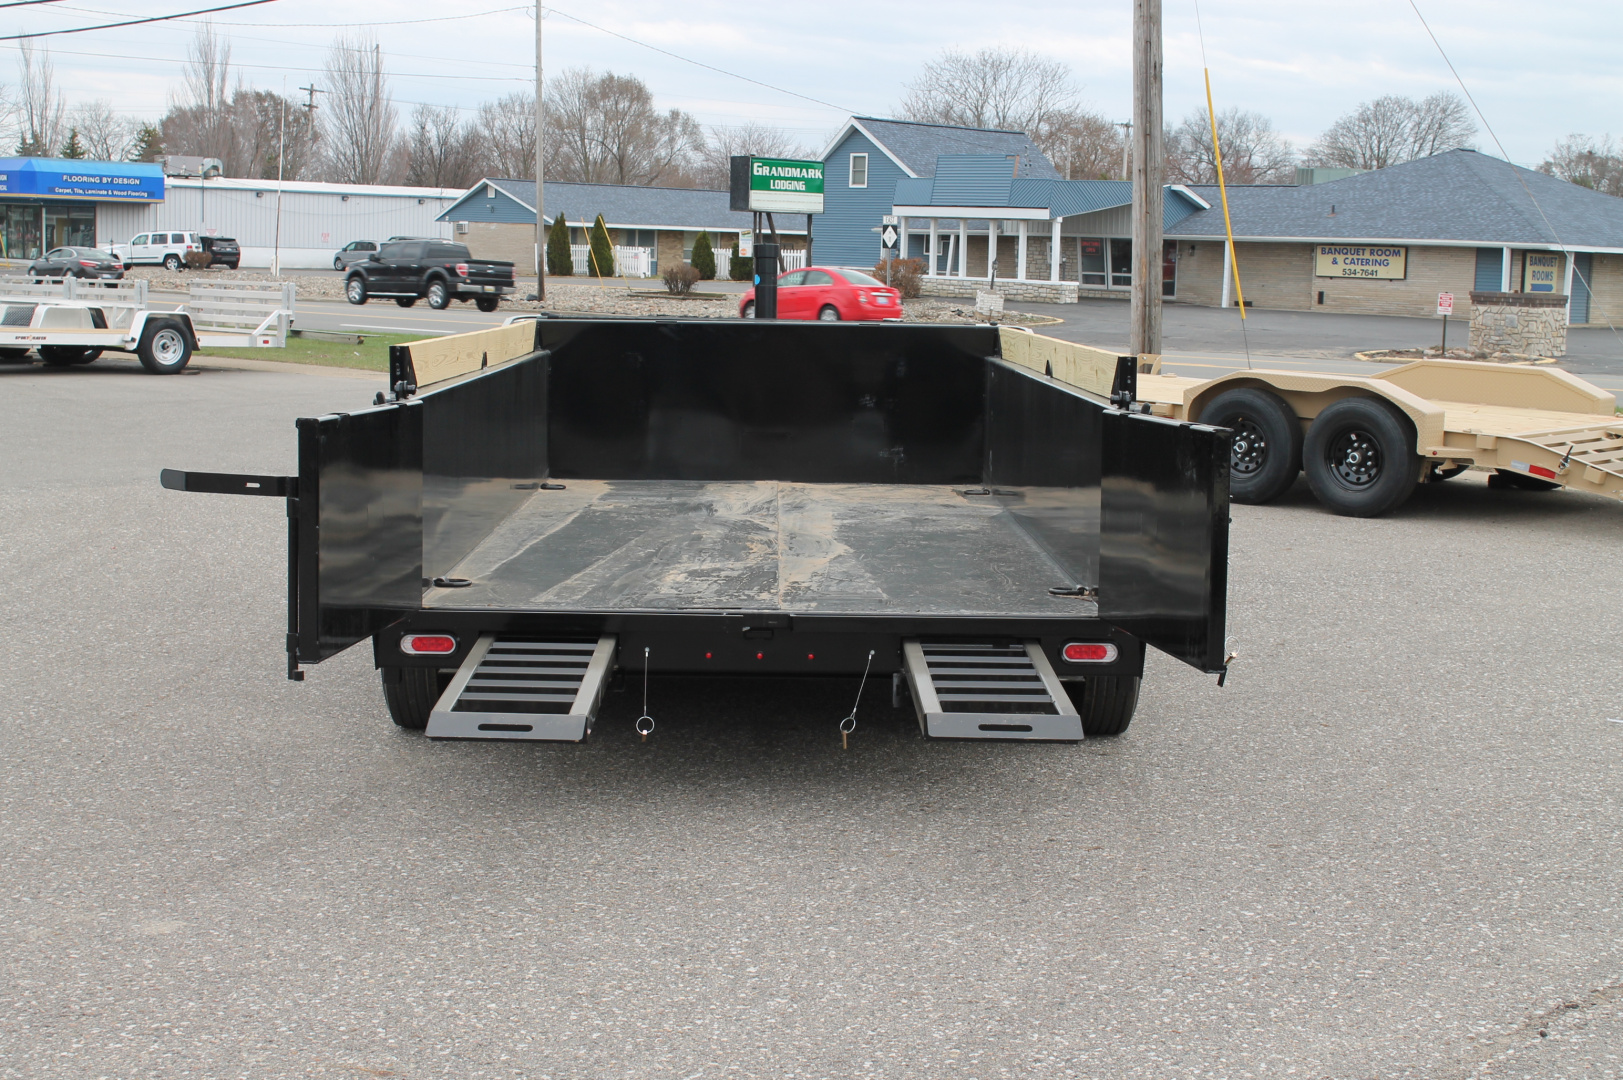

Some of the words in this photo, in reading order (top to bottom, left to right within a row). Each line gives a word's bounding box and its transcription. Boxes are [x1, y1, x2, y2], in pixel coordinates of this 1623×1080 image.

[753, 162, 823, 179] GRANDMARK
[62, 174, 101, 184] FLOORING
[102, 176, 112, 184] BY
[113, 177, 140, 185] DESIGN
[770, 179, 806, 191] LODGING
[54, 187, 73, 195] Carpet,
[85, 188, 108, 196] Laminate
[113, 189, 127, 197] Wood
[128, 190, 148, 198] Flooring
[1321, 247, 1367, 256] BANQUET
[1369, 248, 1401, 257] ROOM
[1331, 257, 1338, 265] &
[1343, 257, 1390, 267] CATERING
[1529, 255, 1558, 267] BANQUET
[1342, 268, 1378, 277] 534-7641
[1531, 270, 1554, 281] ROOMS
